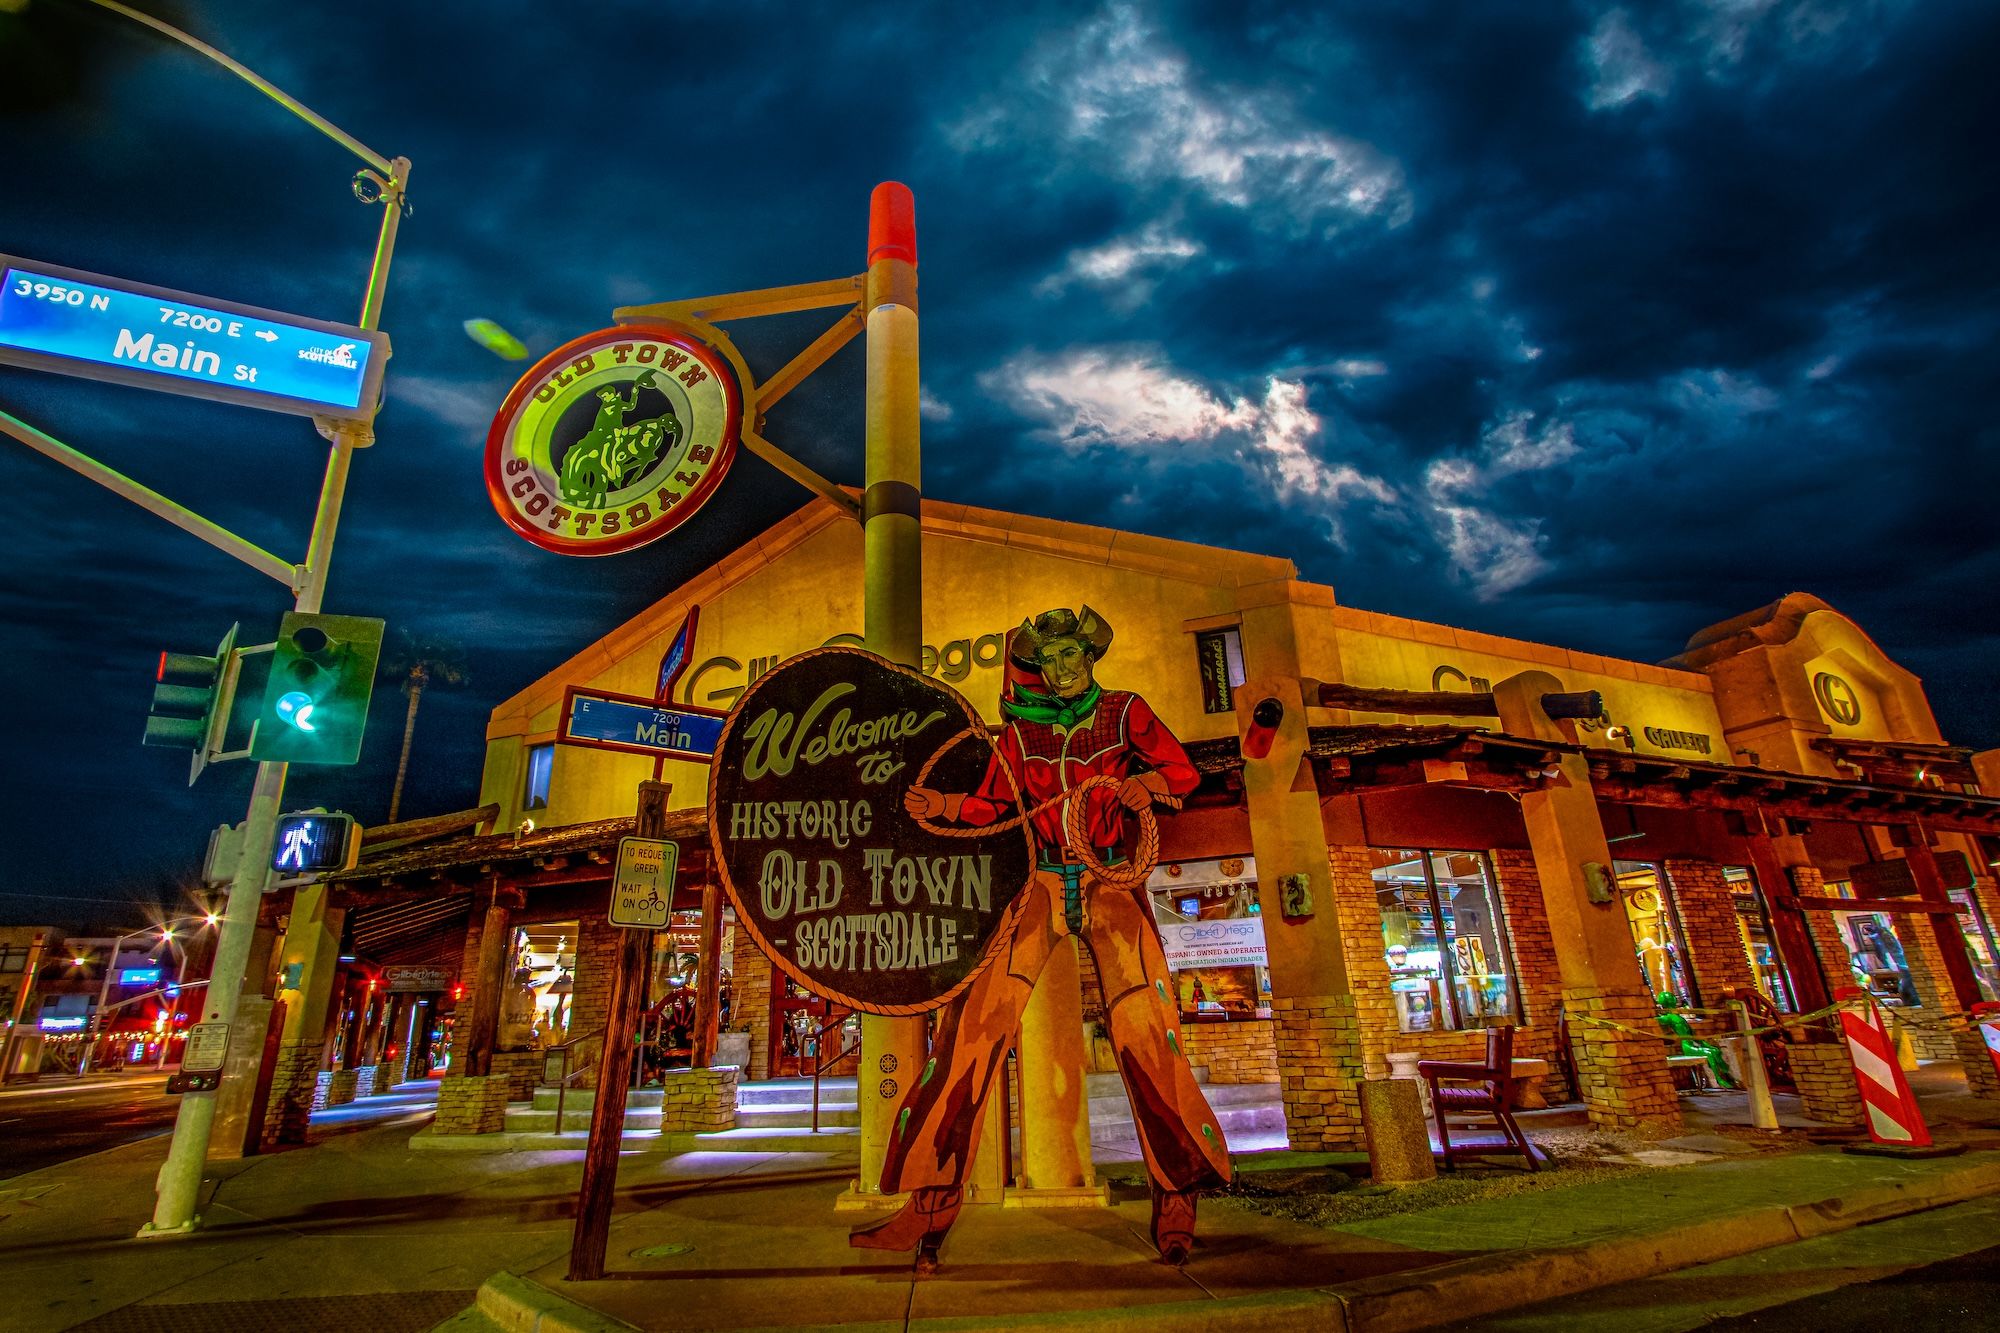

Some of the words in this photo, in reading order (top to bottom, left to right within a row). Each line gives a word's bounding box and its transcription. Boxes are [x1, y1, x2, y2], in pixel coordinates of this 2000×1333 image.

[14, 280, 85, 306] 3950
[90, 295, 110, 311] N
[159, 307, 222, 333] 7200
[227, 322, 244, 337] E
[112, 328, 221, 376] Main
[233, 364, 258, 383] St
[298, 349, 358, 369] SCOTTSALE
[532, 354, 596, 403] OLD
[612, 344, 708, 388] TOWN
[506, 444, 715, 536] SCOTTSDALE
[583, 702, 590, 712] E
[652, 712, 681, 725] 7200
[635, 721, 692, 748] Main
[743, 683, 946, 780] Welcome
[856, 751, 906, 785] to
[729, 800, 873, 847] HISTORIC
[626, 848, 635, 857] TO
[638, 848, 672, 860] REQUEST
[634, 863, 660, 874] GREEN
[622, 883, 642, 894] WAIT
[758, 849, 845, 920] OLD
[863, 849, 993, 912] TOWN
[622, 899, 636, 909] ON
[795, 911, 959, 972] SCOTTSDALE
[1179, 926, 1219, 941] Gilbert
[1210, 923, 1254, 939] Ortega
[1181, 958, 1217, 967] GENERATION
[1239, 955, 1263, 963] TRADER
[1196, 948, 1222, 957] OWNED
